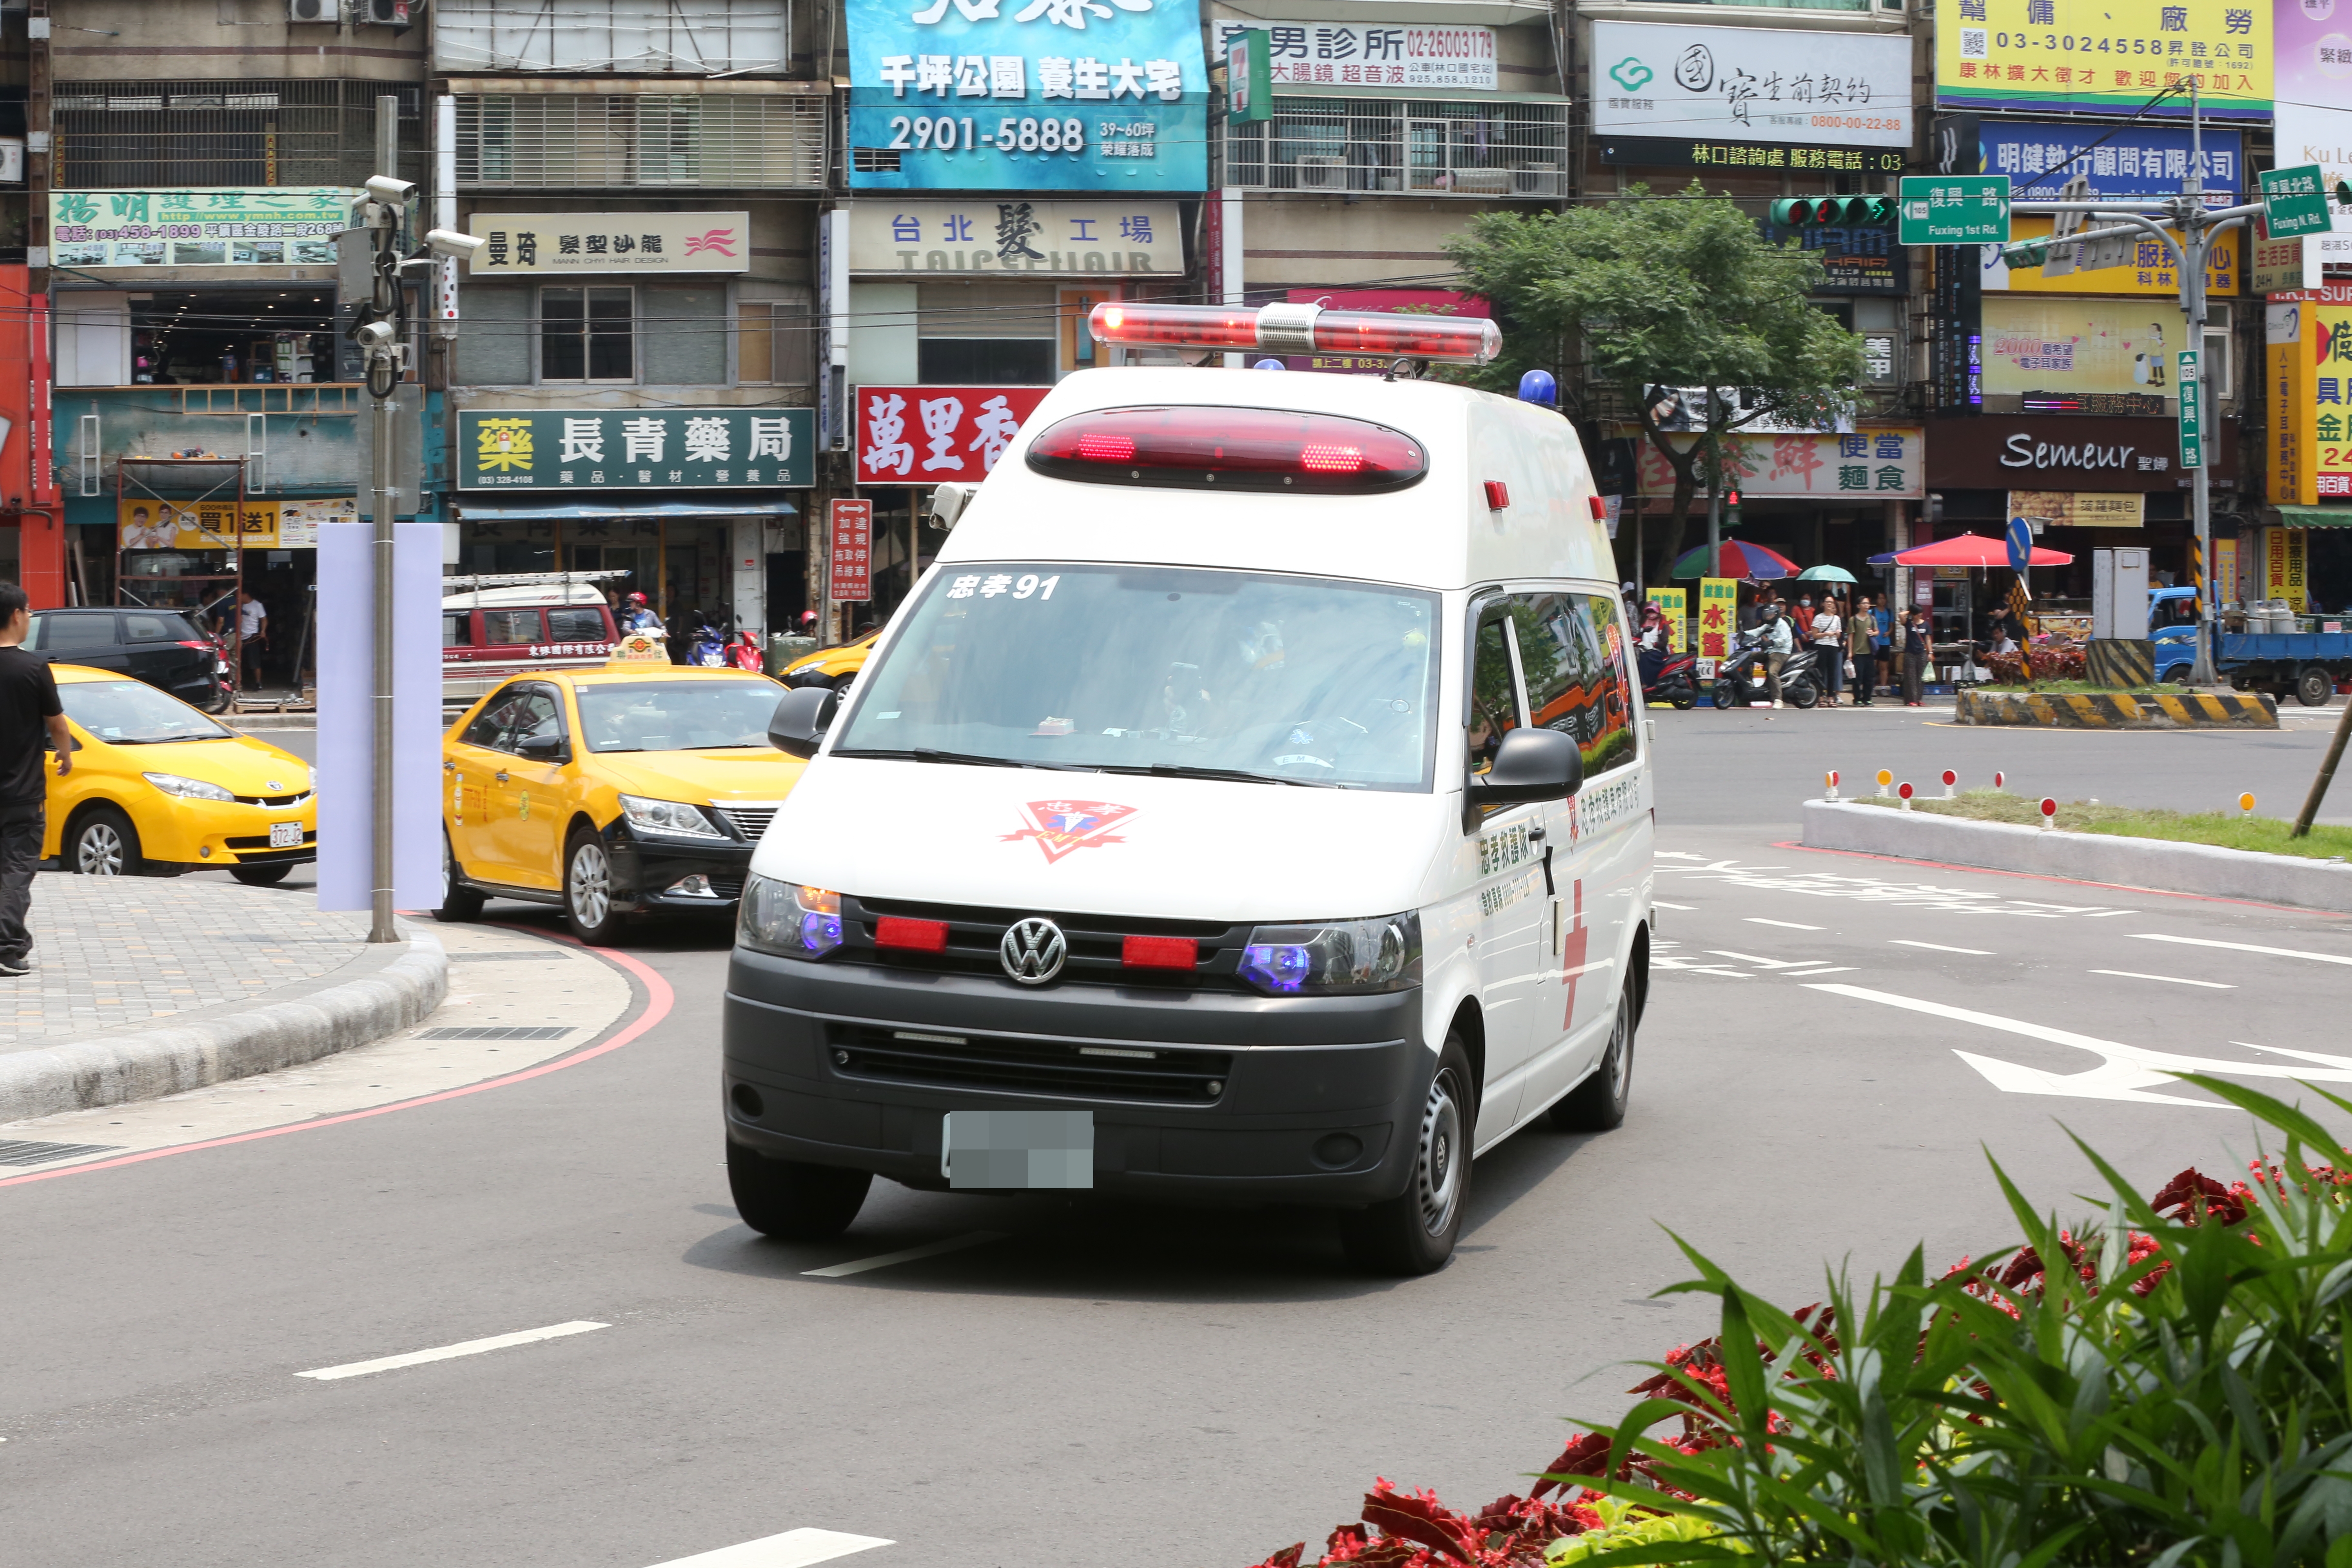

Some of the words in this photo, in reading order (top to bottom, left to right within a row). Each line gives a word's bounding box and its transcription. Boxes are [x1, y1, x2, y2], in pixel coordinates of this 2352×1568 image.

[1408, 30, 1492, 58] 02-26003179
[1996, 32, 2162, 55] 03-3024558
[880, 54, 1026, 98] 千坪公園
[1038, 57, 1182, 100] 養生大宅
[1271, 62, 1334, 82] 大腸鏡
[1341, 64, 1405, 84] 超音波
[1960, 62, 2096, 84] 康林擴大徵才
[889, 116, 1083, 152] 2901-5888
[1812, 116, 1901, 130] 0800-00-22-88
[1692, 144, 1785, 167] 林口諮詢處
[1998, 143, 2233, 181] 明健執行顧問有限公司
[2304, 145, 2329, 163] Ku
[1930, 187, 1998, 207] 復興一路
[1929, 225, 1963, 237] Fuxing
[1965, 225, 1980, 234] 1st
[1982, 225, 1998, 234] Rd.
[488, 232, 537, 266] 曼琦
[559, 234, 663, 254] 髮型沙龍
[862, 394, 1020, 475] 萬里香
[2183, 385, 2197, 464] 復興一路
[477, 418, 534, 472] 藥
[559, 416, 793, 464] 長青藥局
[1839, 433, 1905, 459] 便當
[2000, 433, 2134, 469] Semeur
[497, 475, 534, 485] 328-4108
[1839, 465, 1905, 491] 麵食
[200, 511, 274, 533] 買1送1
[855, 517, 867, 577] 違規停車
[2270, 530, 2285, 587] 日用百貨
[946, 574, 1061, 601] 忠孝91
[1283, 755, 1321, 764] EMT
[1038, 801, 1126, 815] 忠孝
[1036, 830, 1087, 844] EMT
[1480, 822, 1528, 875] 忠孝救護隊
